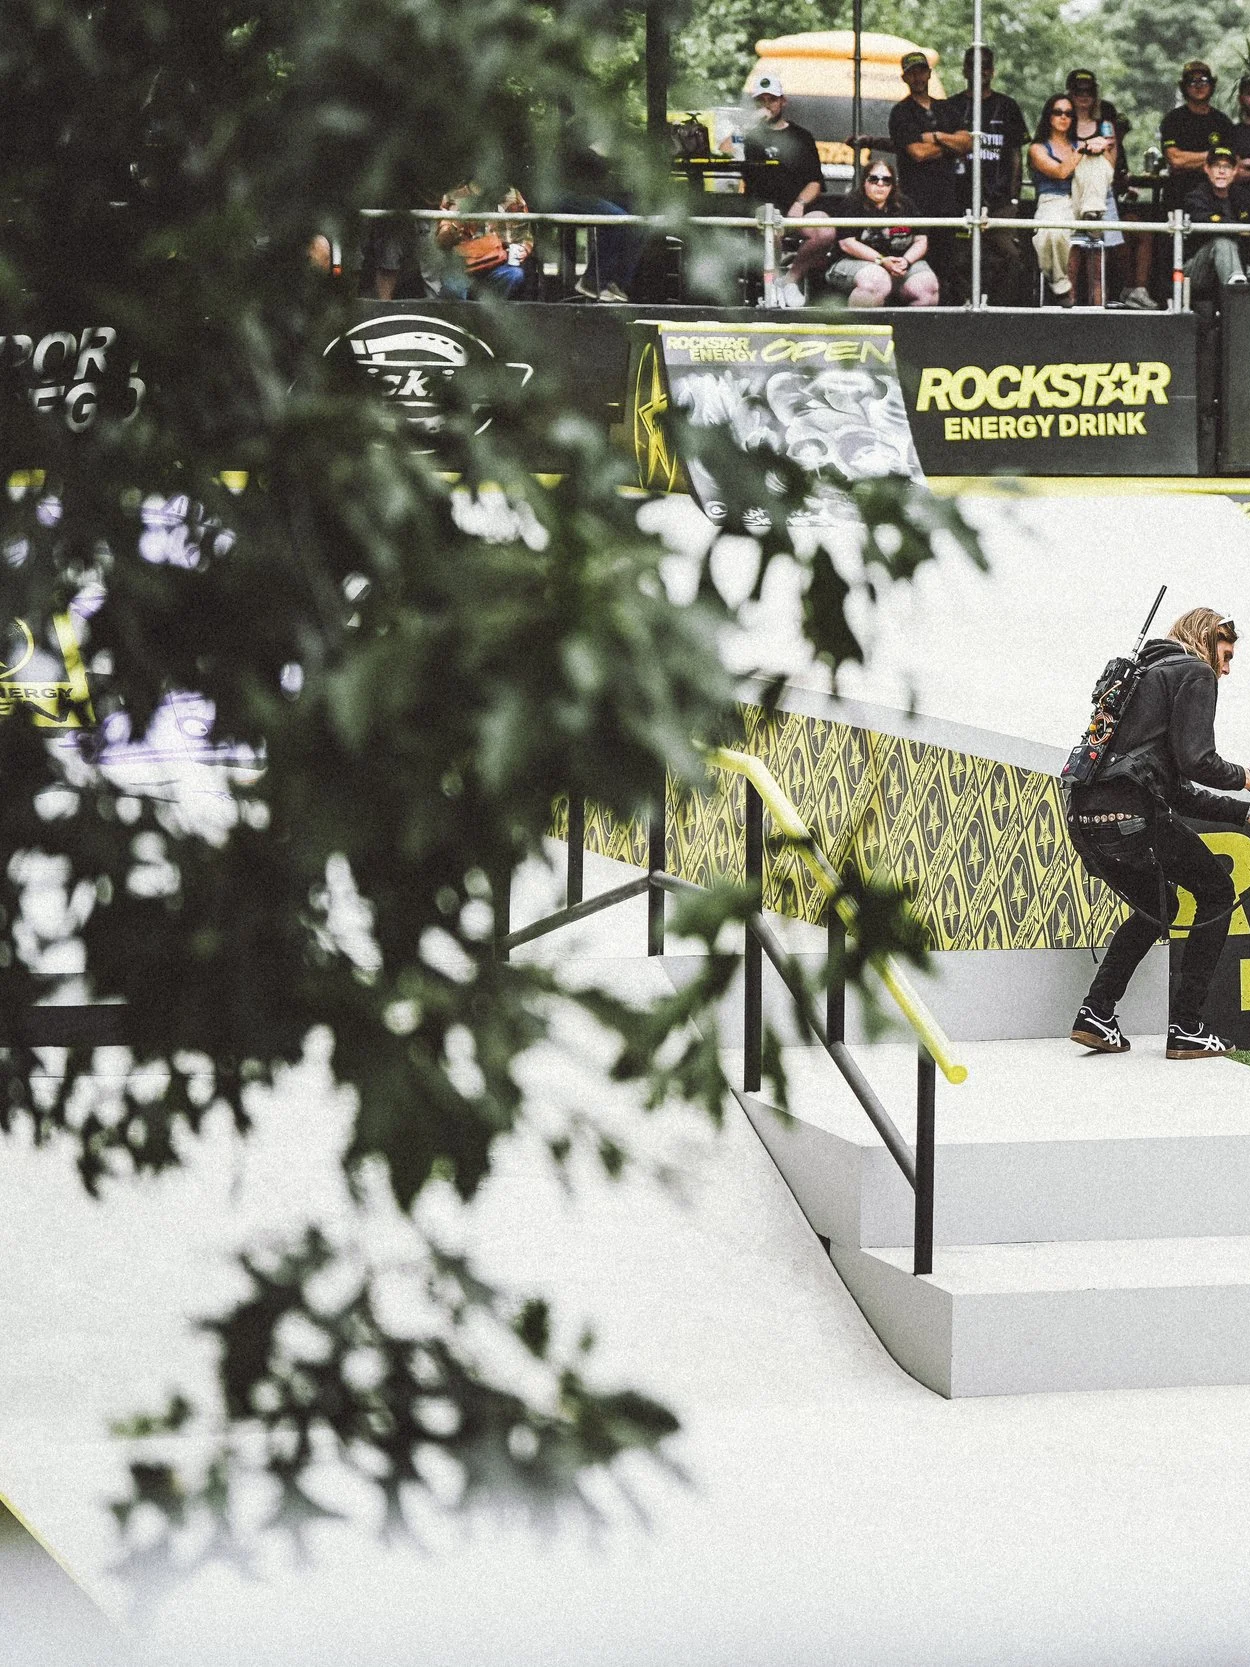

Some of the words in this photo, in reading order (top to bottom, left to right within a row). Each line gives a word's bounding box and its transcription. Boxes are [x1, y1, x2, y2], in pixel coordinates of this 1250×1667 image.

[666, 336, 750, 350] ROCKSTAR
[690, 348, 758, 363] ENERGY
[760, 337, 895, 364] OPEN
[915, 361, 1172, 412] ROCKSTAR
[944, 414, 1055, 441] ENERGY
[1058, 411, 1147, 438] DRINK
